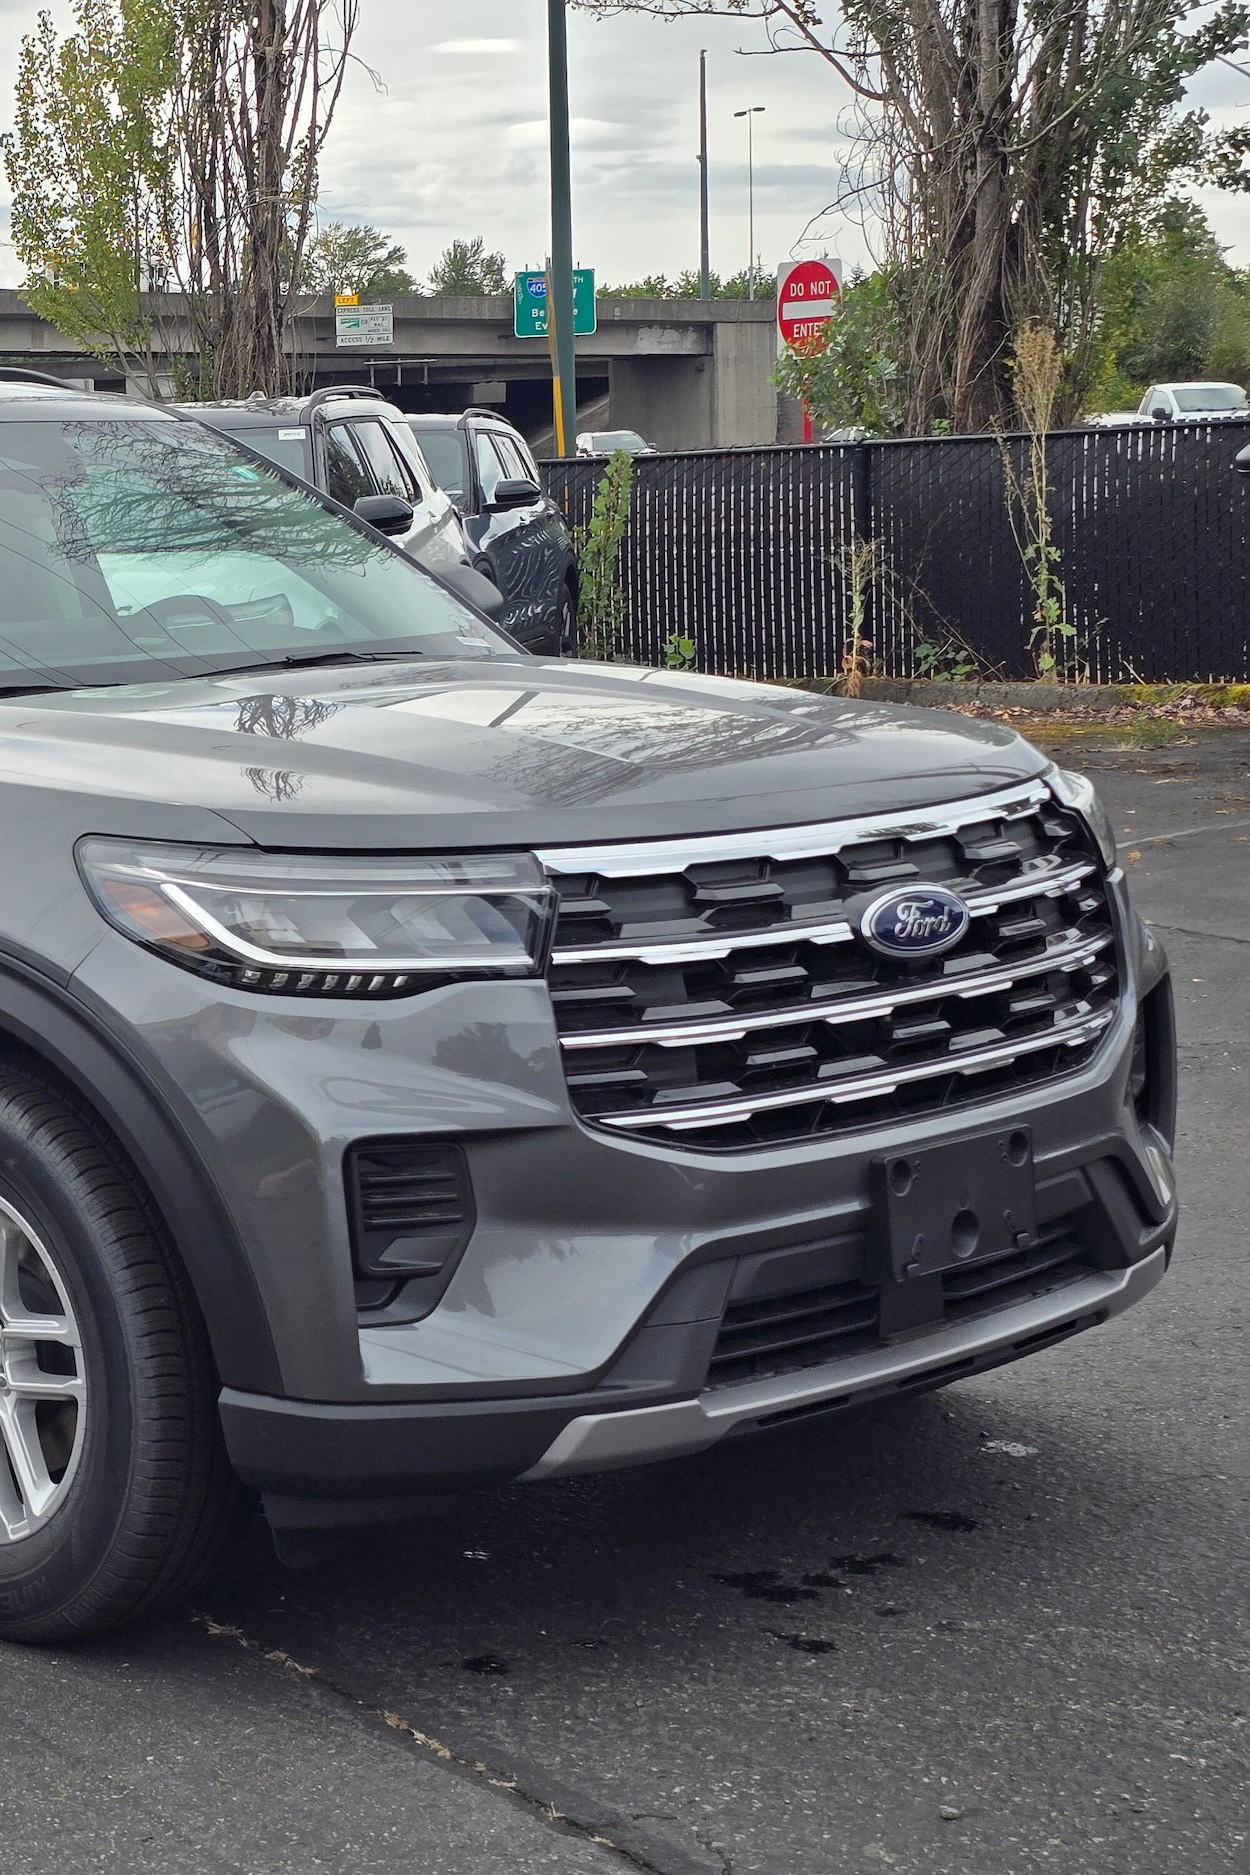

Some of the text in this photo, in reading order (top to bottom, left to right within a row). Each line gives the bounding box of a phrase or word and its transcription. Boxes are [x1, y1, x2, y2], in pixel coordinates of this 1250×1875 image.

[529, 283, 547, 293] 405
[790, 280, 831, 297] DO NOT
[793, 322, 823, 339] ENTE
[894, 899, 952, 942] Ford
